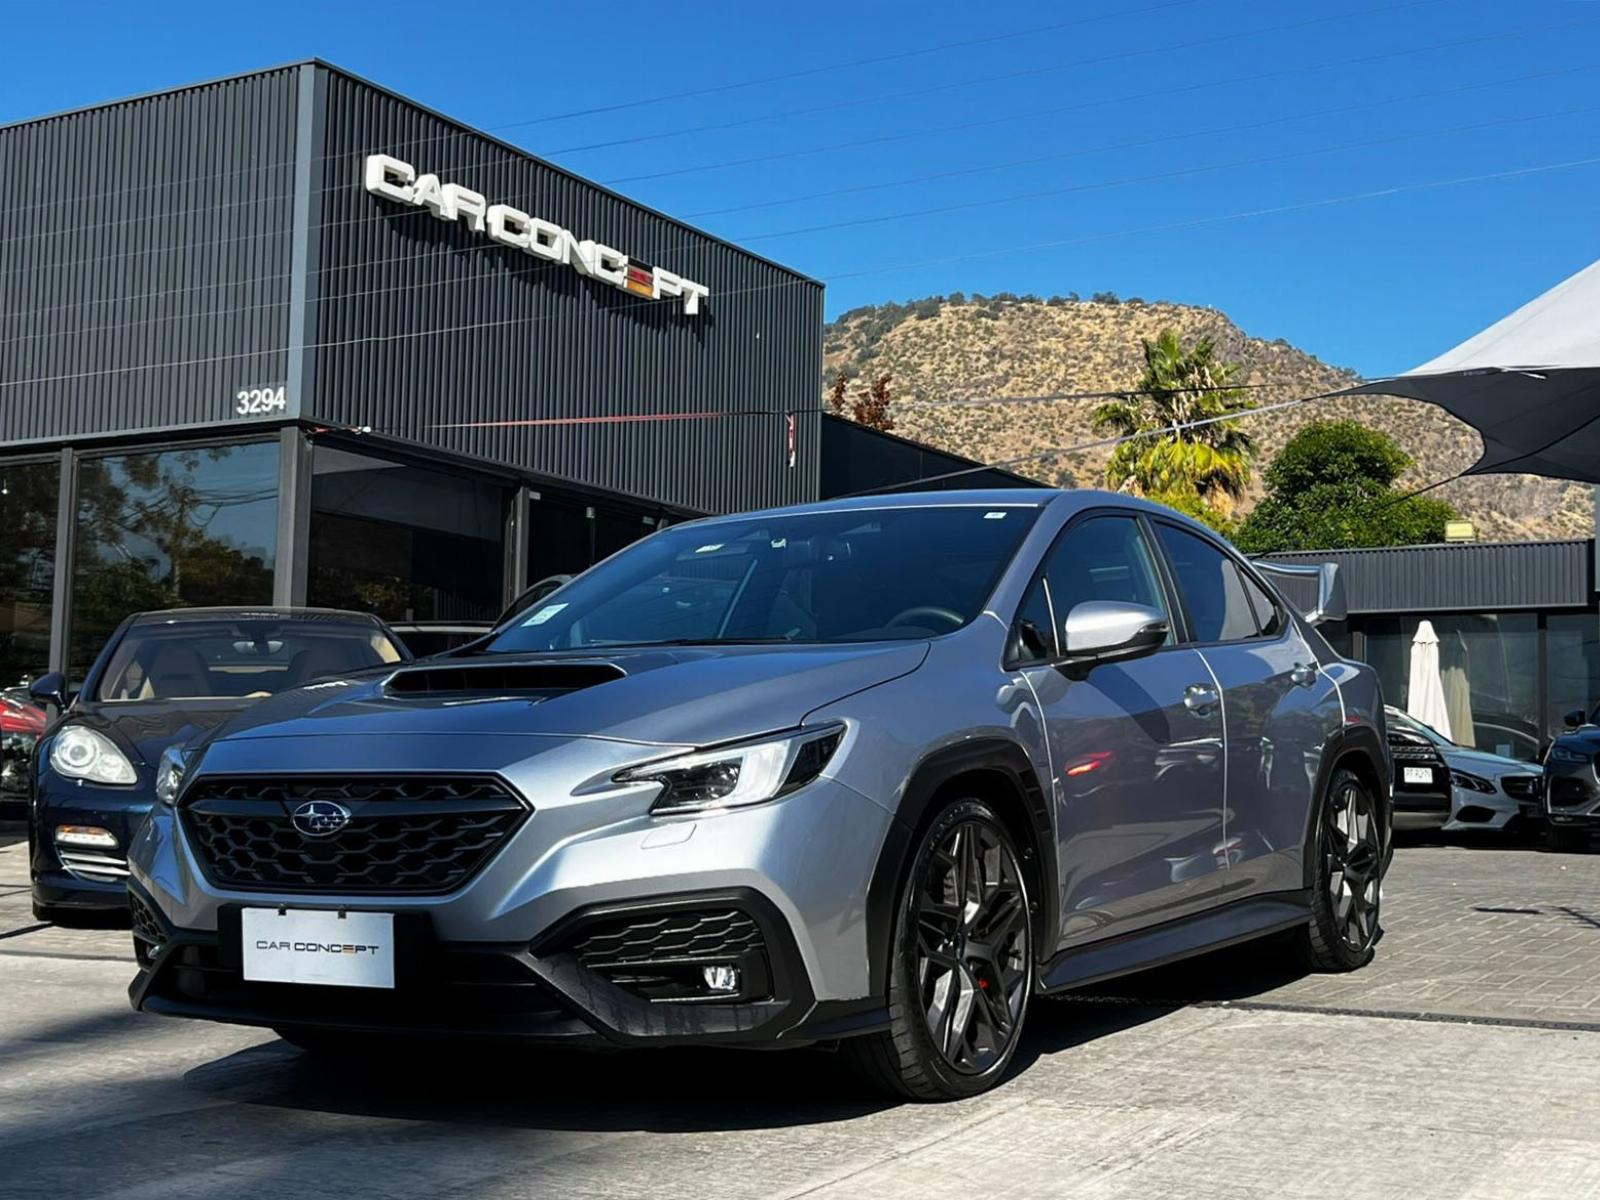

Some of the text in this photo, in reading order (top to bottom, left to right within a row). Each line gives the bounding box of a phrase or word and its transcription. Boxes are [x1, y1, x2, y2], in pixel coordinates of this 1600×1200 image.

[236, 386, 286, 415] 3294
[256, 940, 379, 955] CAR CONCEPT
